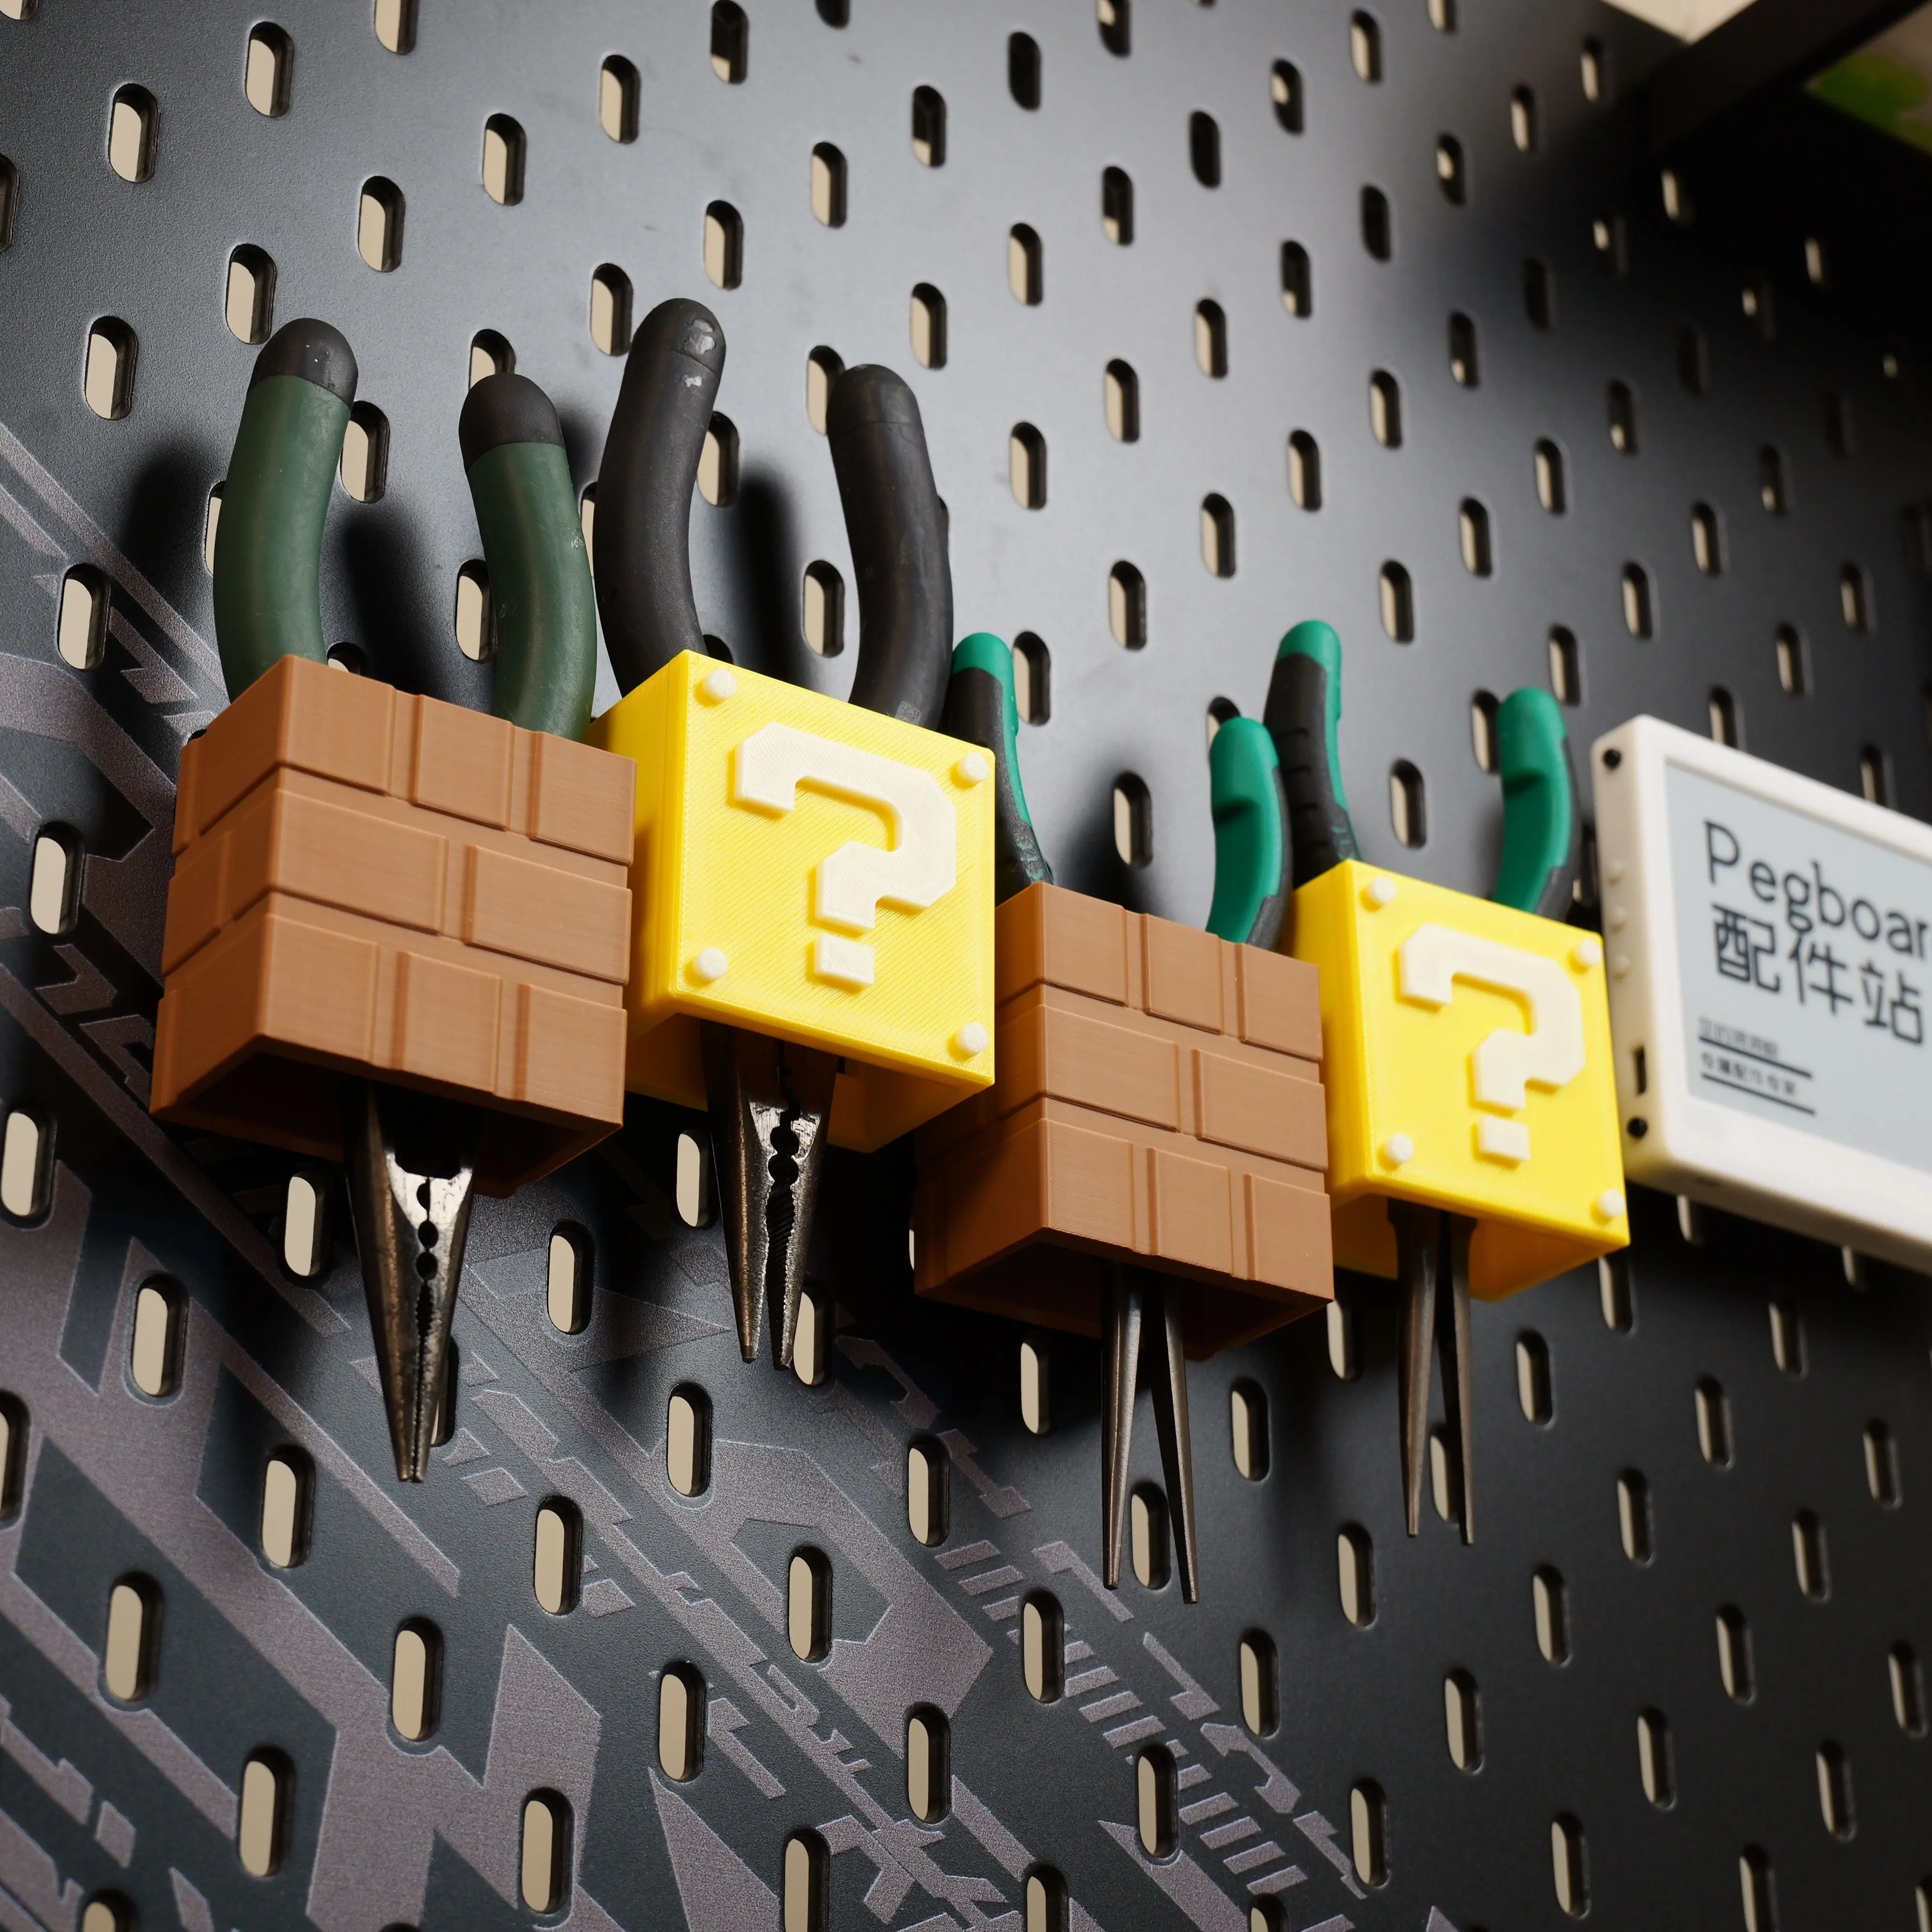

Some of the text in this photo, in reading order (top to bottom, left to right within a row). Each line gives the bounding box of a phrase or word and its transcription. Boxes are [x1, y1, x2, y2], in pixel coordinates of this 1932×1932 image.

[734, 721, 957, 984] ?
[1703, 819, 1932, 962] Pegboar
[1400, 923, 1586, 1161] ?
[1710, 903, 1924, 1047] 配件站
